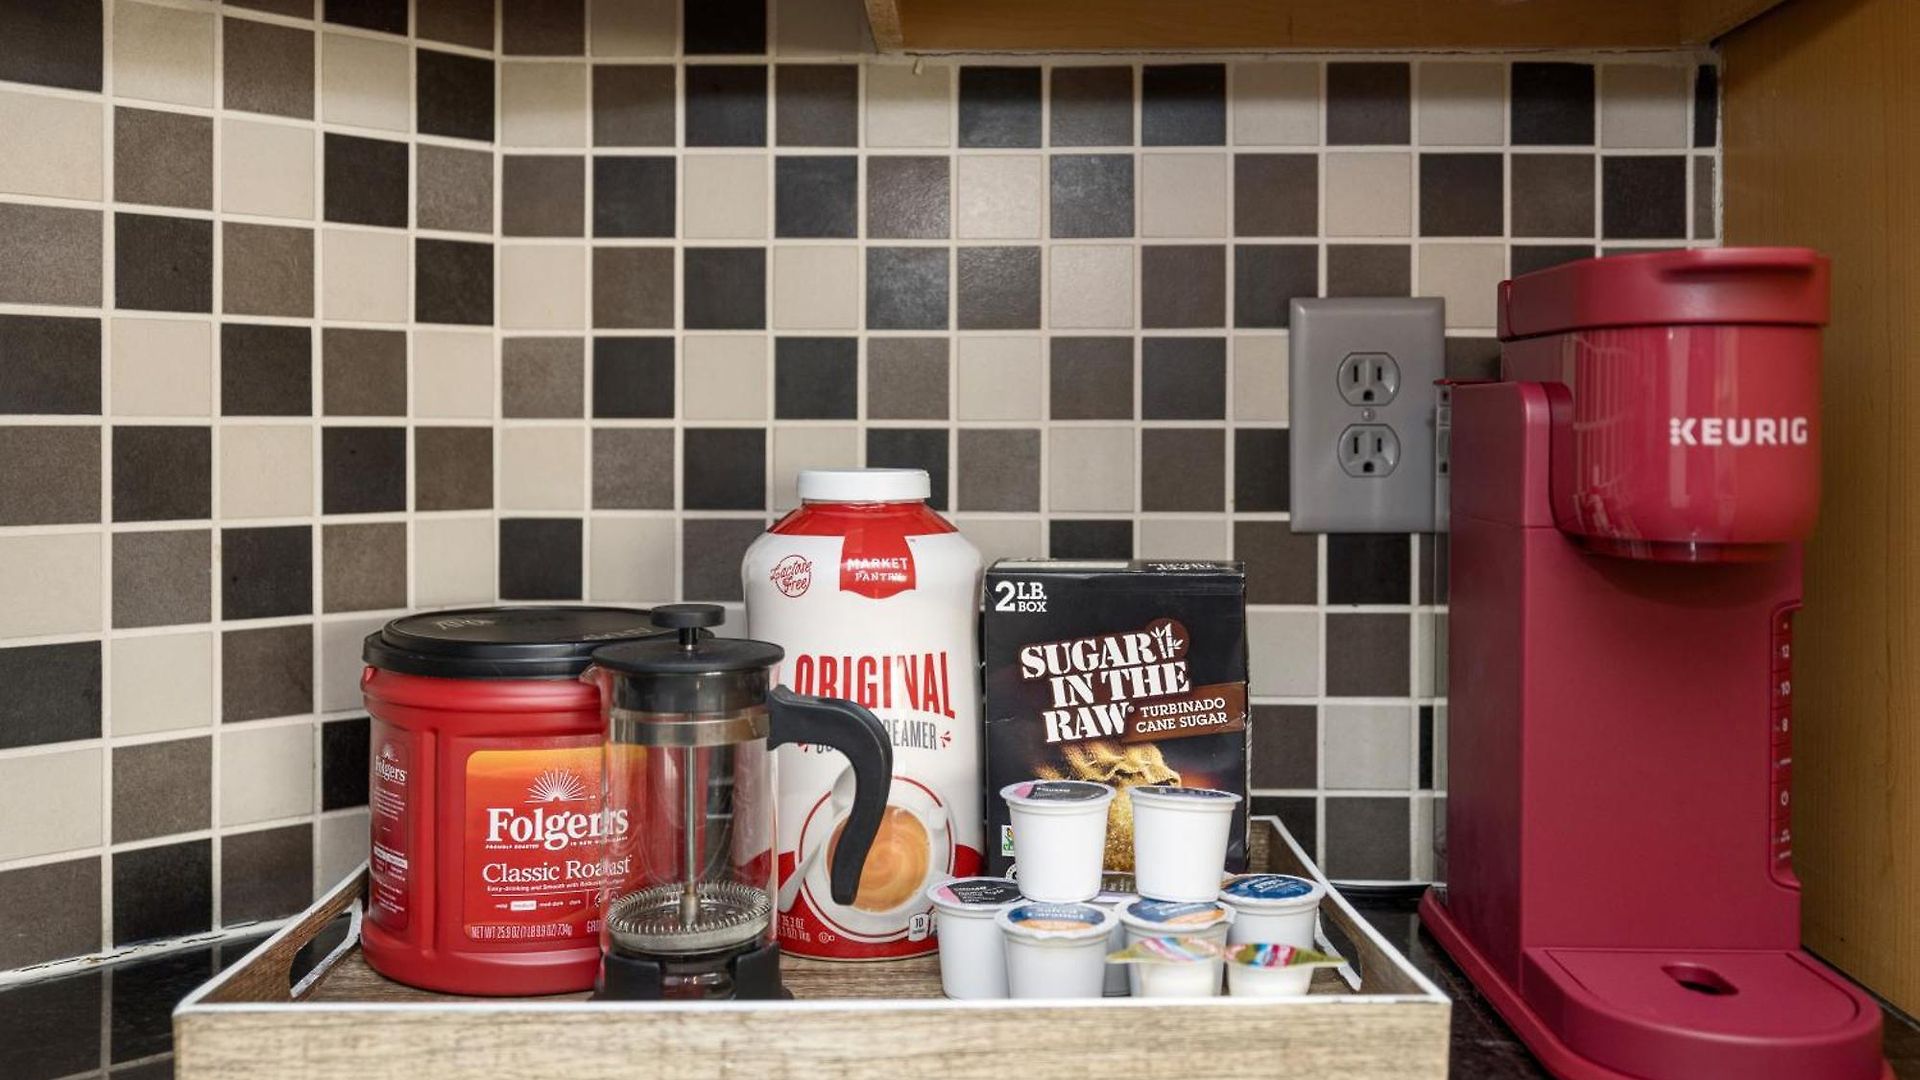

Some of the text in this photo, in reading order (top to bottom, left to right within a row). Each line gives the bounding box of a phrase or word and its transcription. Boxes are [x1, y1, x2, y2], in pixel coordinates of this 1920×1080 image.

[1669, 417, 1808, 446] KEURIG
[769, 561, 812, 580] Lactose
[847, 557, 908, 572] MARKET
[782, 577, 807, 593] Free
[995, 580, 1047, 612] 2 LB.
[1017, 601, 1047, 613] BOX
[1020, 632, 1157, 679] SUGAR
[794, 651, 955, 719] ORIGINAL
[1049, 661, 1190, 708] IN THE
[1140, 697, 1226, 718] TURBINADO
[883, 719, 937, 750] REAMER
[1042, 702, 1130, 743] RAW
[1135, 713, 1228, 734] CANE SUGAR
[482, 861, 560, 883] Classic
